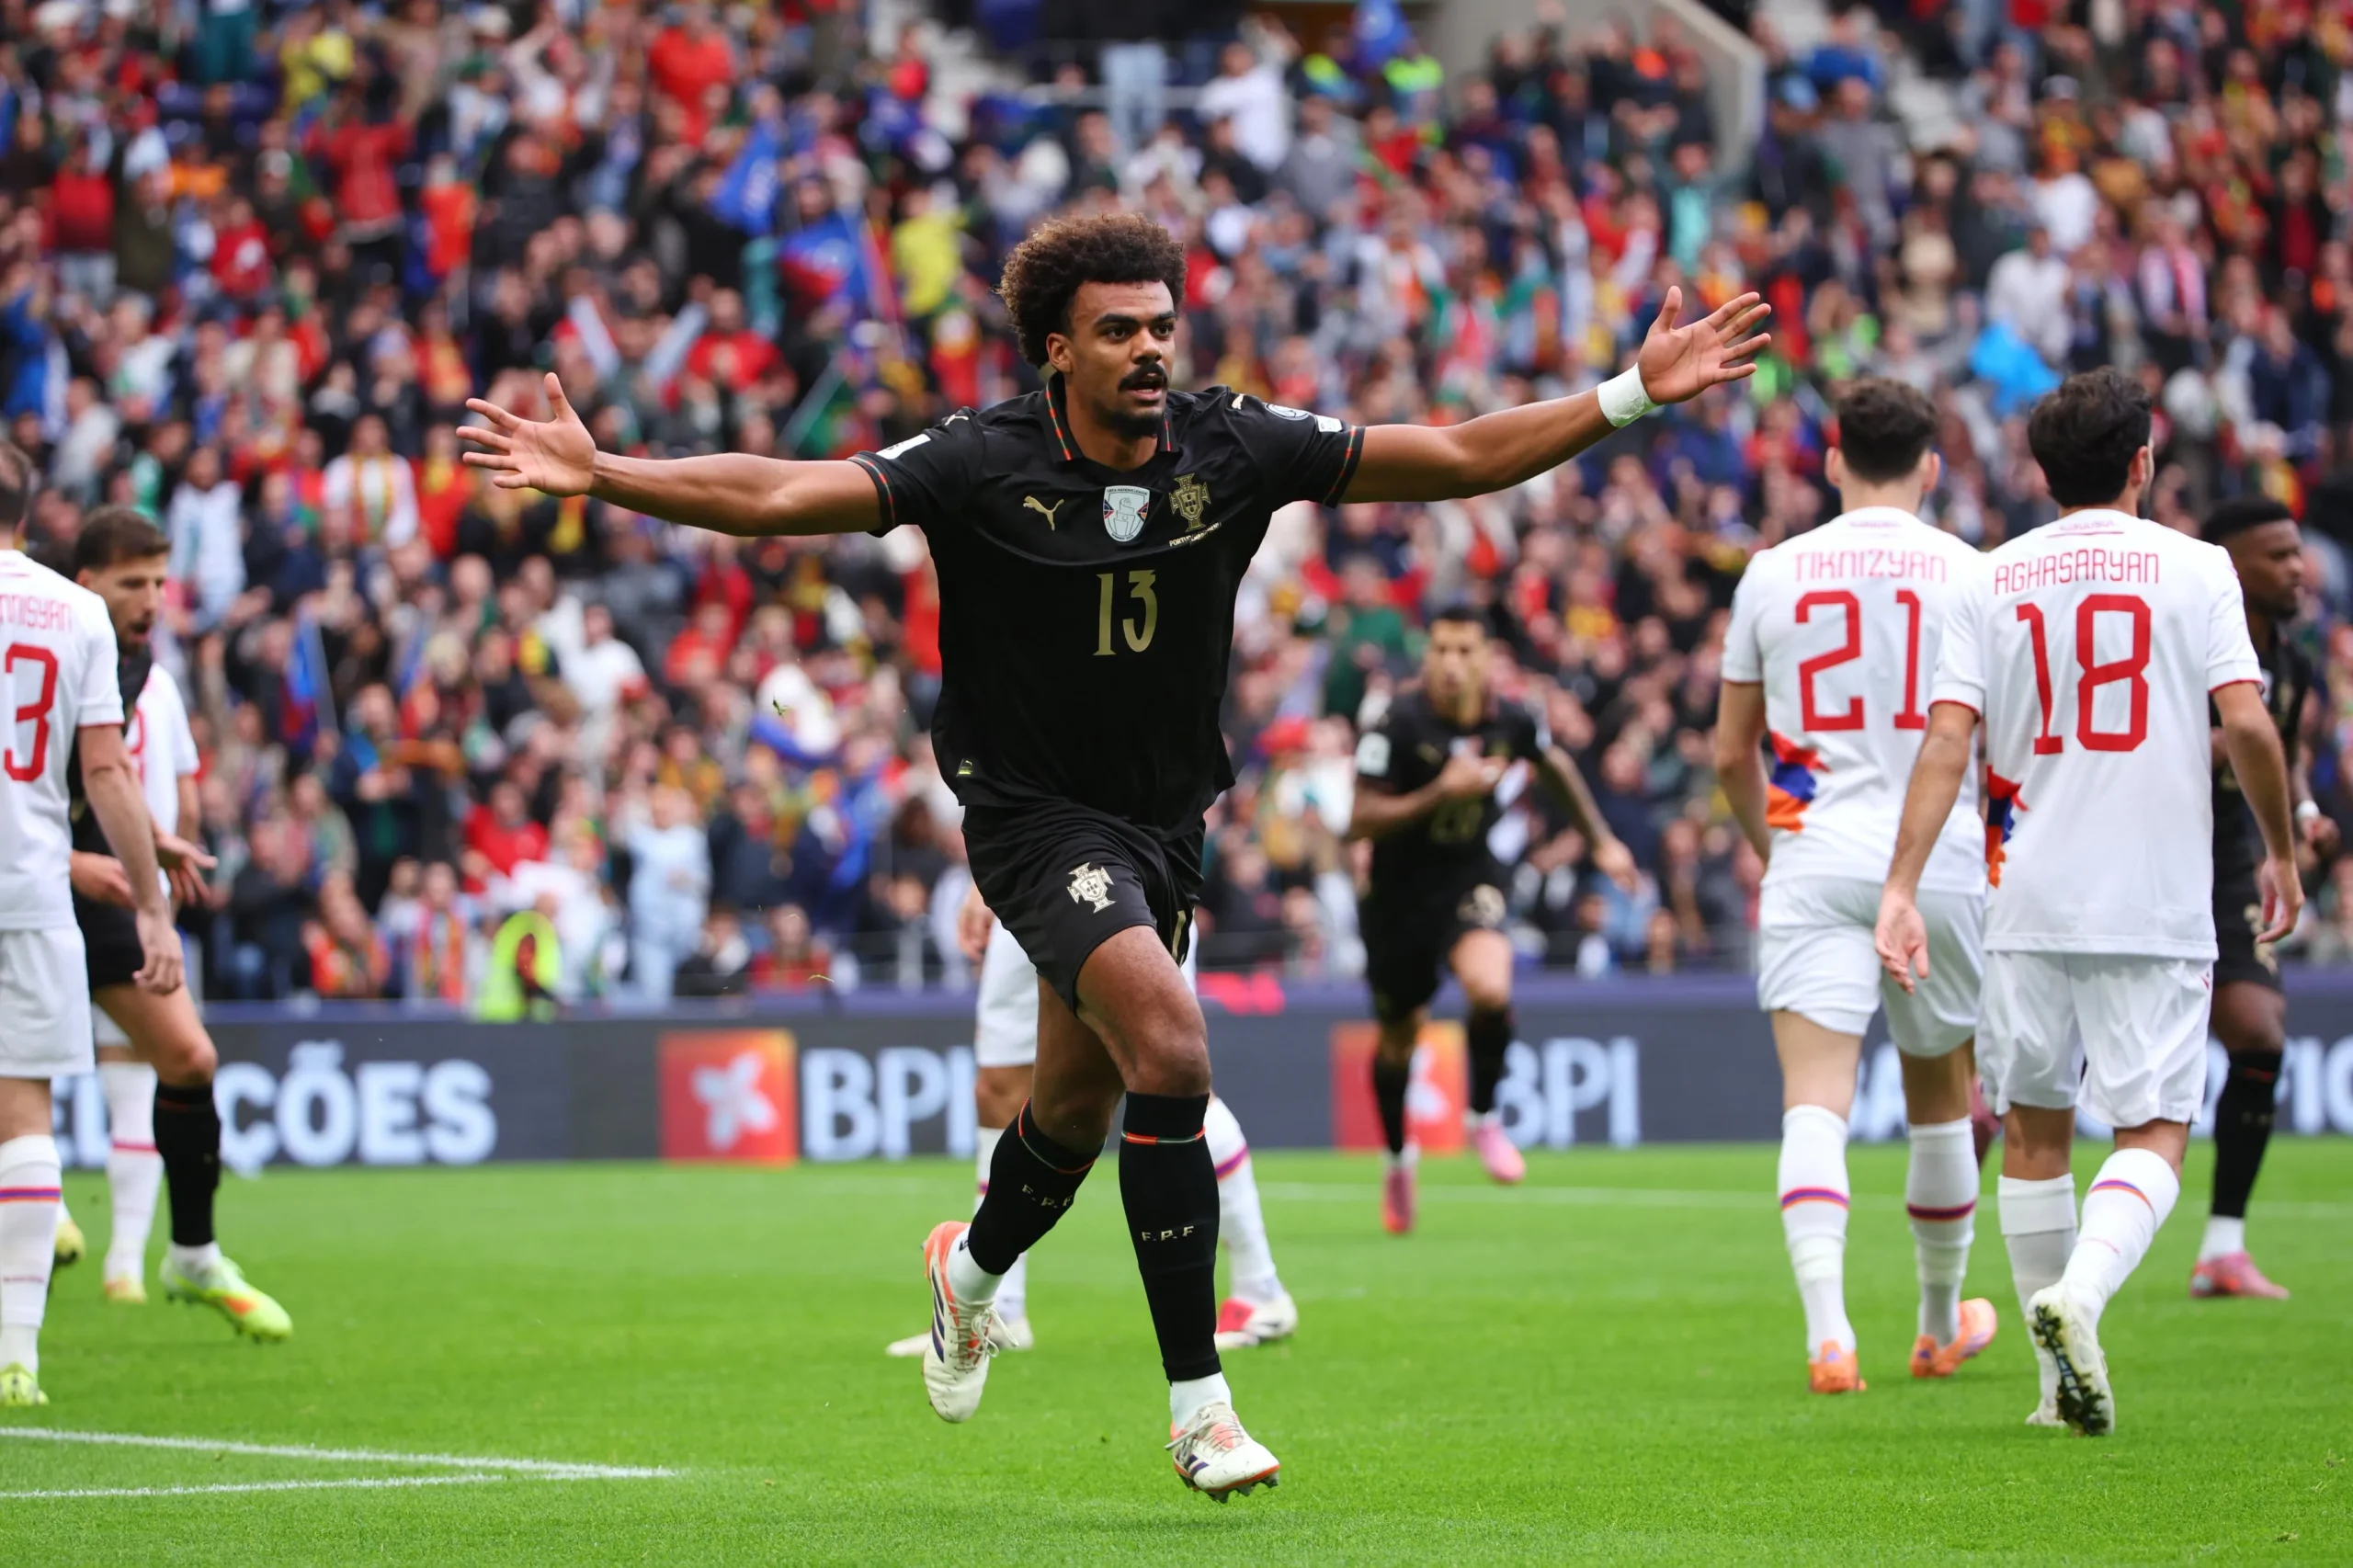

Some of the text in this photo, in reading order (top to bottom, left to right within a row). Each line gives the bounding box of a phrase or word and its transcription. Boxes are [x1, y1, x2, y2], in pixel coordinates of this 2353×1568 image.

[1093, 570, 1158, 656] 13
[1796, 550, 1946, 583] TIKNIZYAN
[1995, 549, 2159, 595] AGHASARYAN
[1795, 589, 1927, 733] 21
[2017, 594, 2152, 756] 18
[802, 1047, 976, 1162] BPI
[1496, 1038, 1641, 1151] BPI
